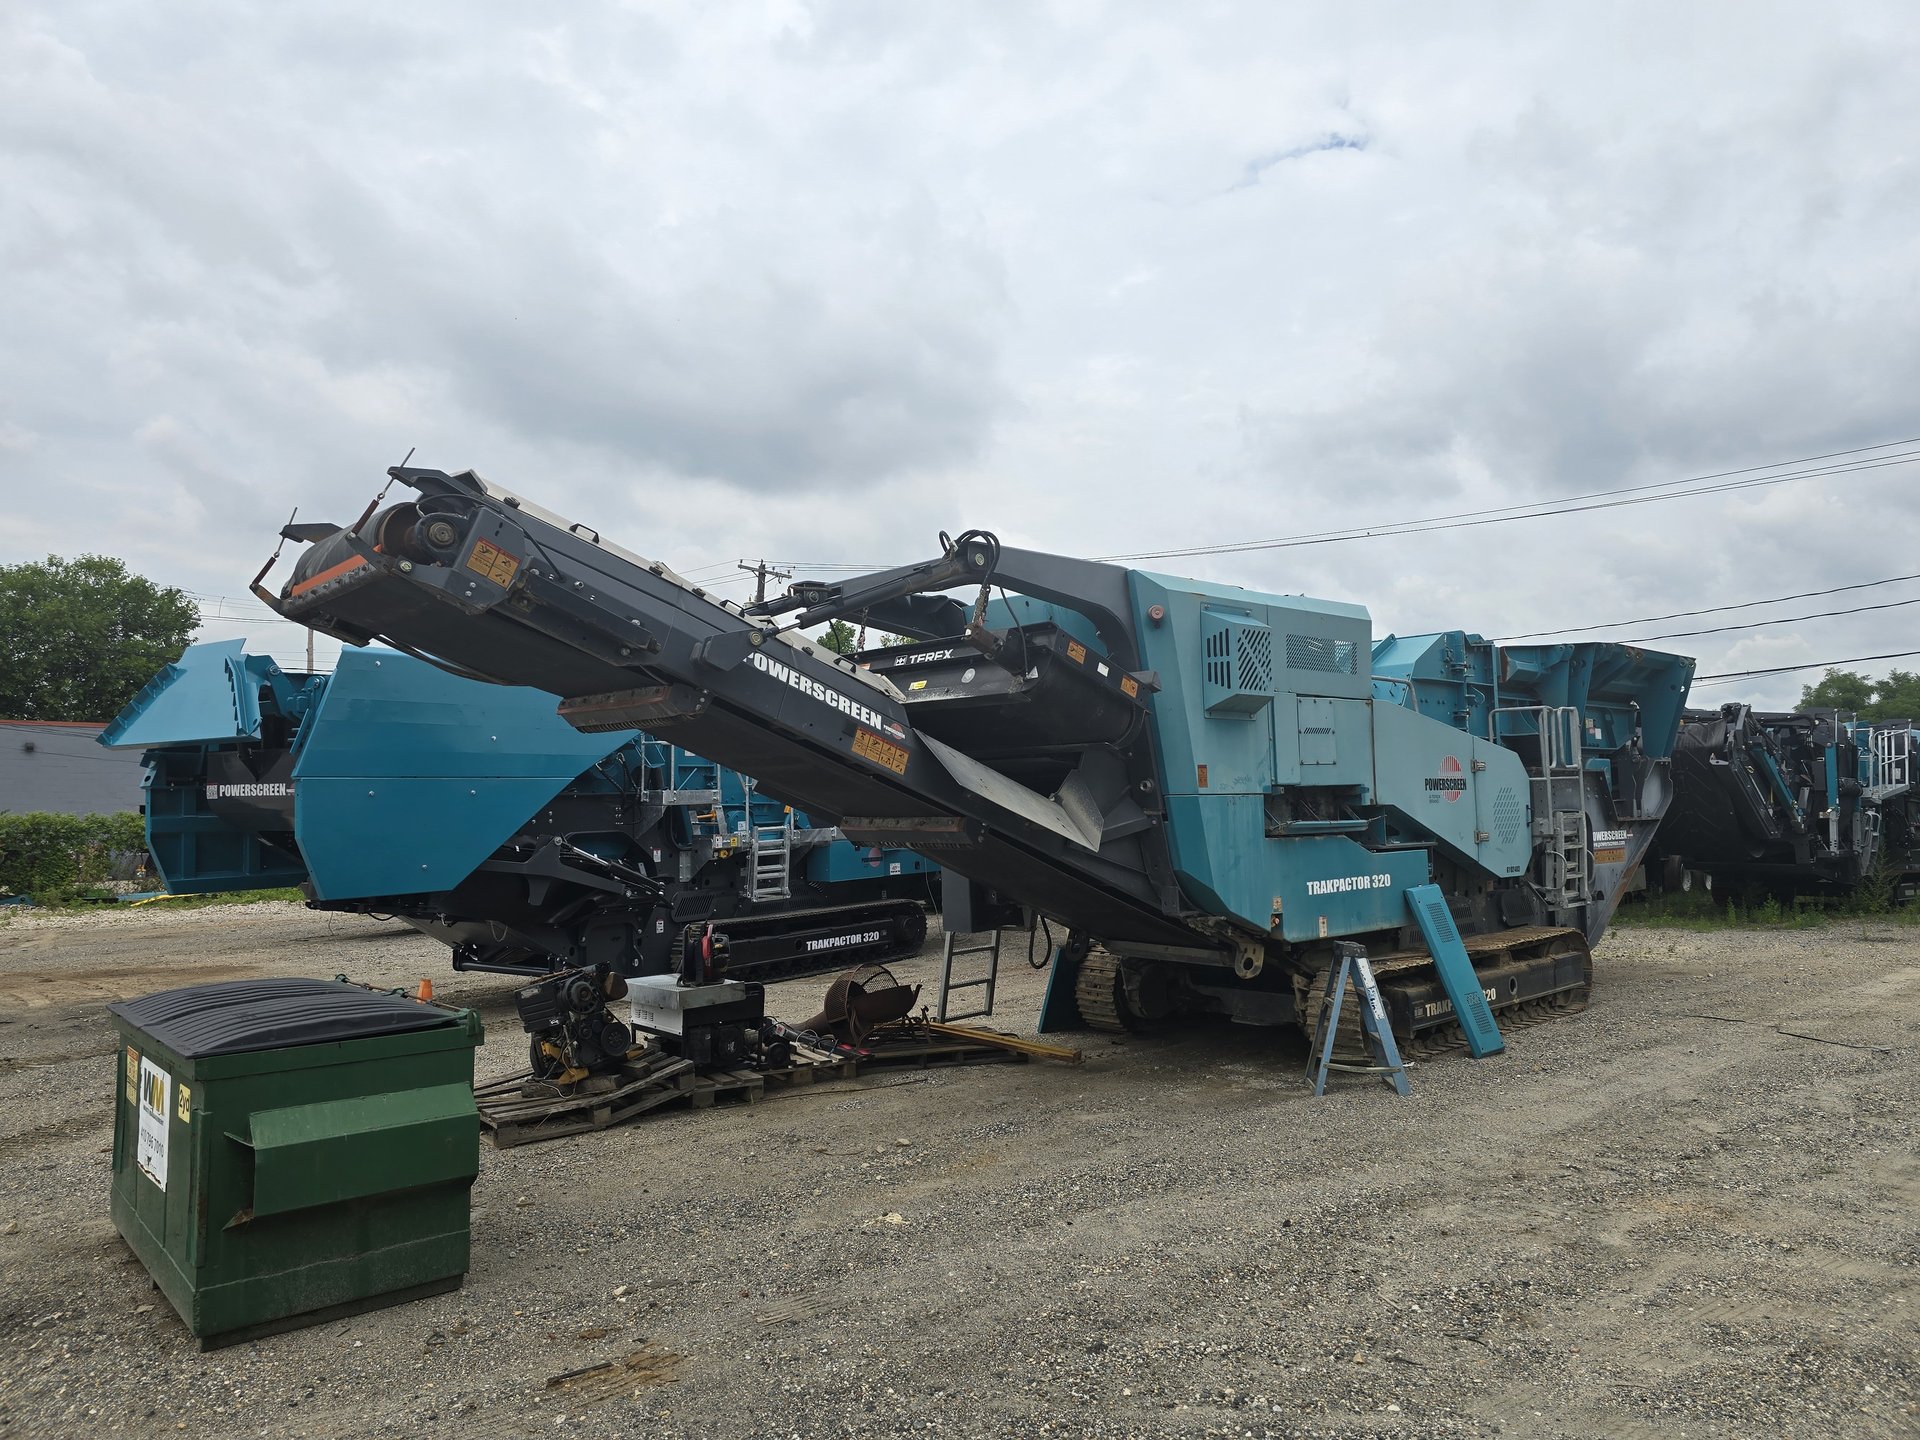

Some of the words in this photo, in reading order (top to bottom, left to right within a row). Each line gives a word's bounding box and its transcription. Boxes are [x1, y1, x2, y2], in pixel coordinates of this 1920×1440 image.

[909, 649, 953, 664] TEREX
[219, 783, 286, 797] POWERSCREEN
[1424, 778, 1467, 791] POWERSCREEN
[1306, 875, 1371, 896] TRAKPACTOR
[1371, 873, 1391, 889] 320
[806, 933, 862, 951] TRAKPACTOR
[863, 931, 880, 942] 320
